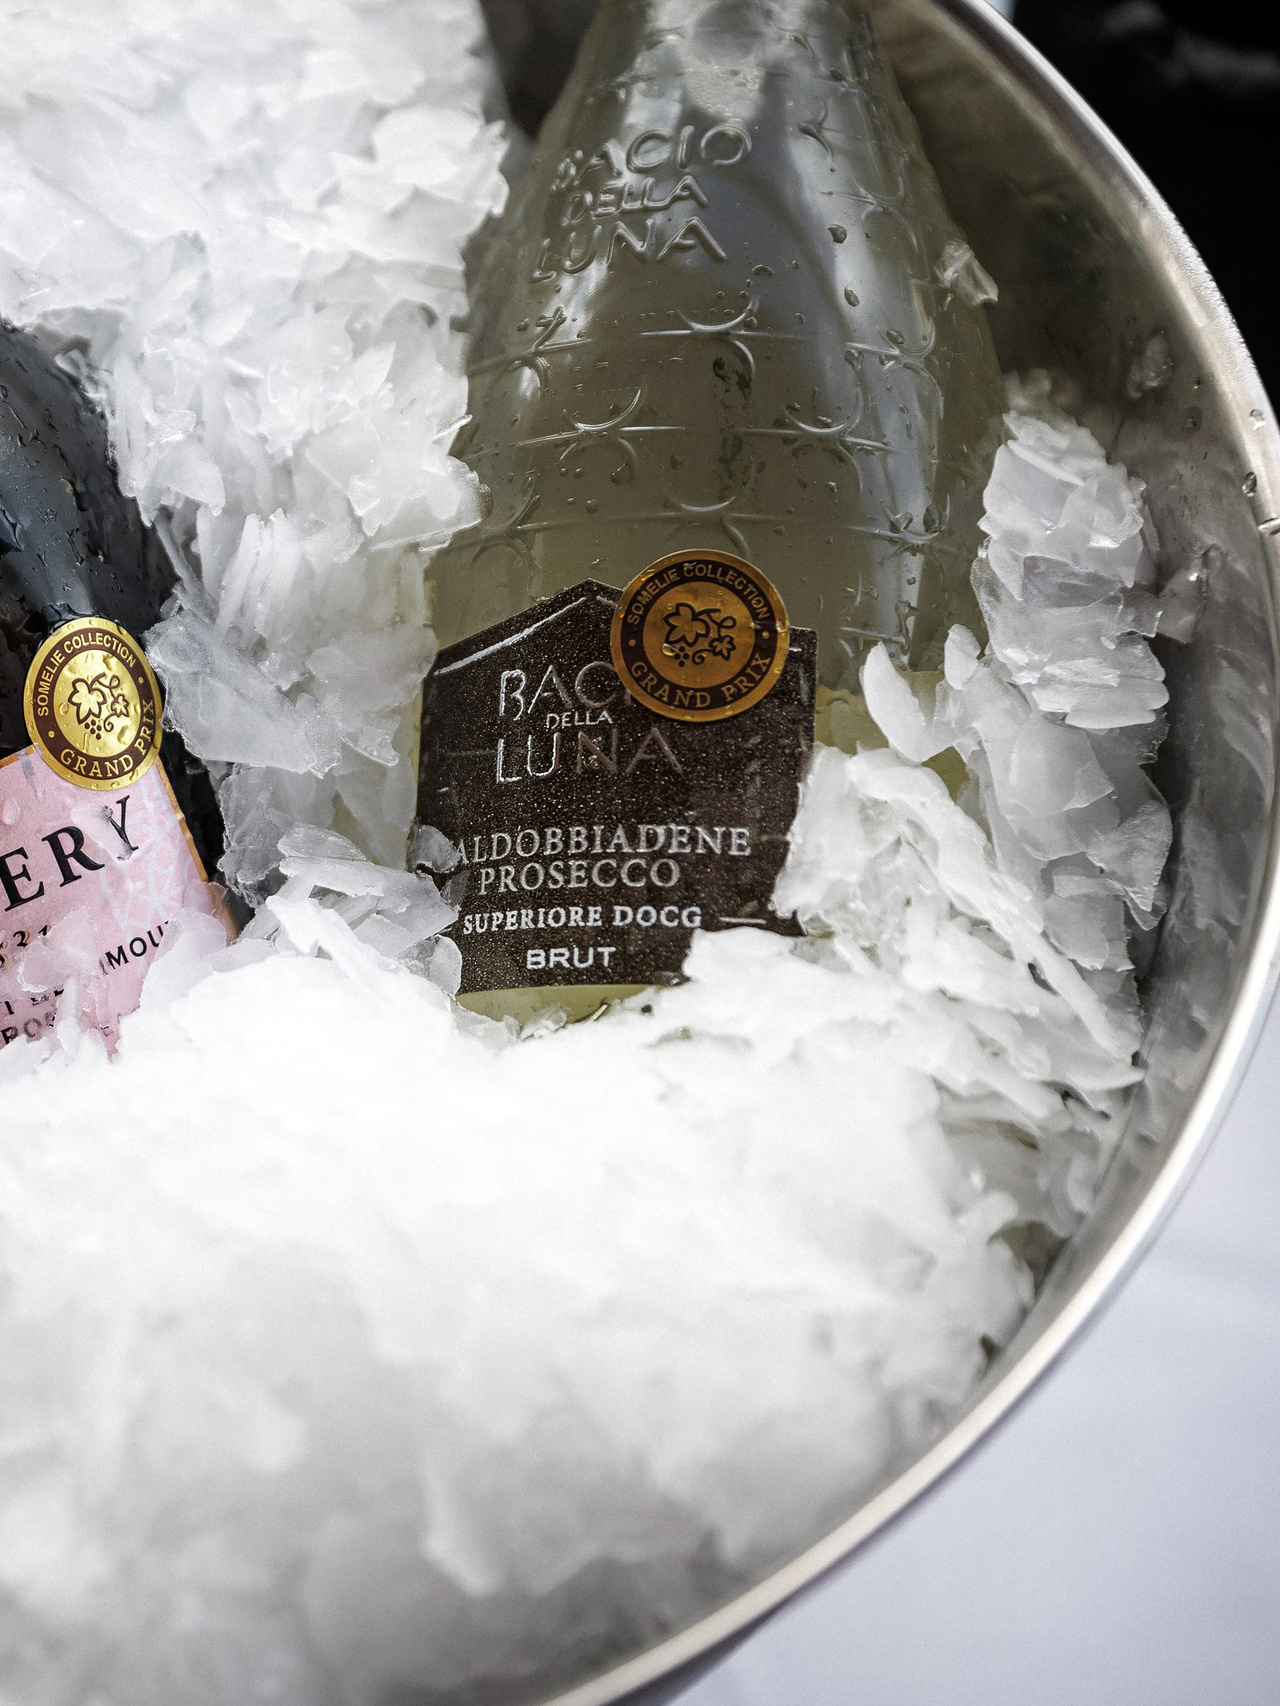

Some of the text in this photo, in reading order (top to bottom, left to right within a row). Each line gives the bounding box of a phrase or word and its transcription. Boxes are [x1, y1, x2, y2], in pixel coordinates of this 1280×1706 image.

[531, 215, 728, 282] LUNA
[627, 563, 771, 625] SOMELIE COLLECTION
[37, 631, 137, 717] SOMELIE COLLECTION
[630, 652, 772, 708] GRAND PRIX
[60, 699, 155, 778] GRAND PRIX
[545, 709, 613, 729] DELLA
[496, 727, 683, 784] LUNA
[457, 823, 752, 866] ALDOBBIADENE
[479, 857, 681, 896] PROSECCO
[462, 904, 702, 936] SUPERIORE DOCG
[525, 945, 617, 971] BRUT
